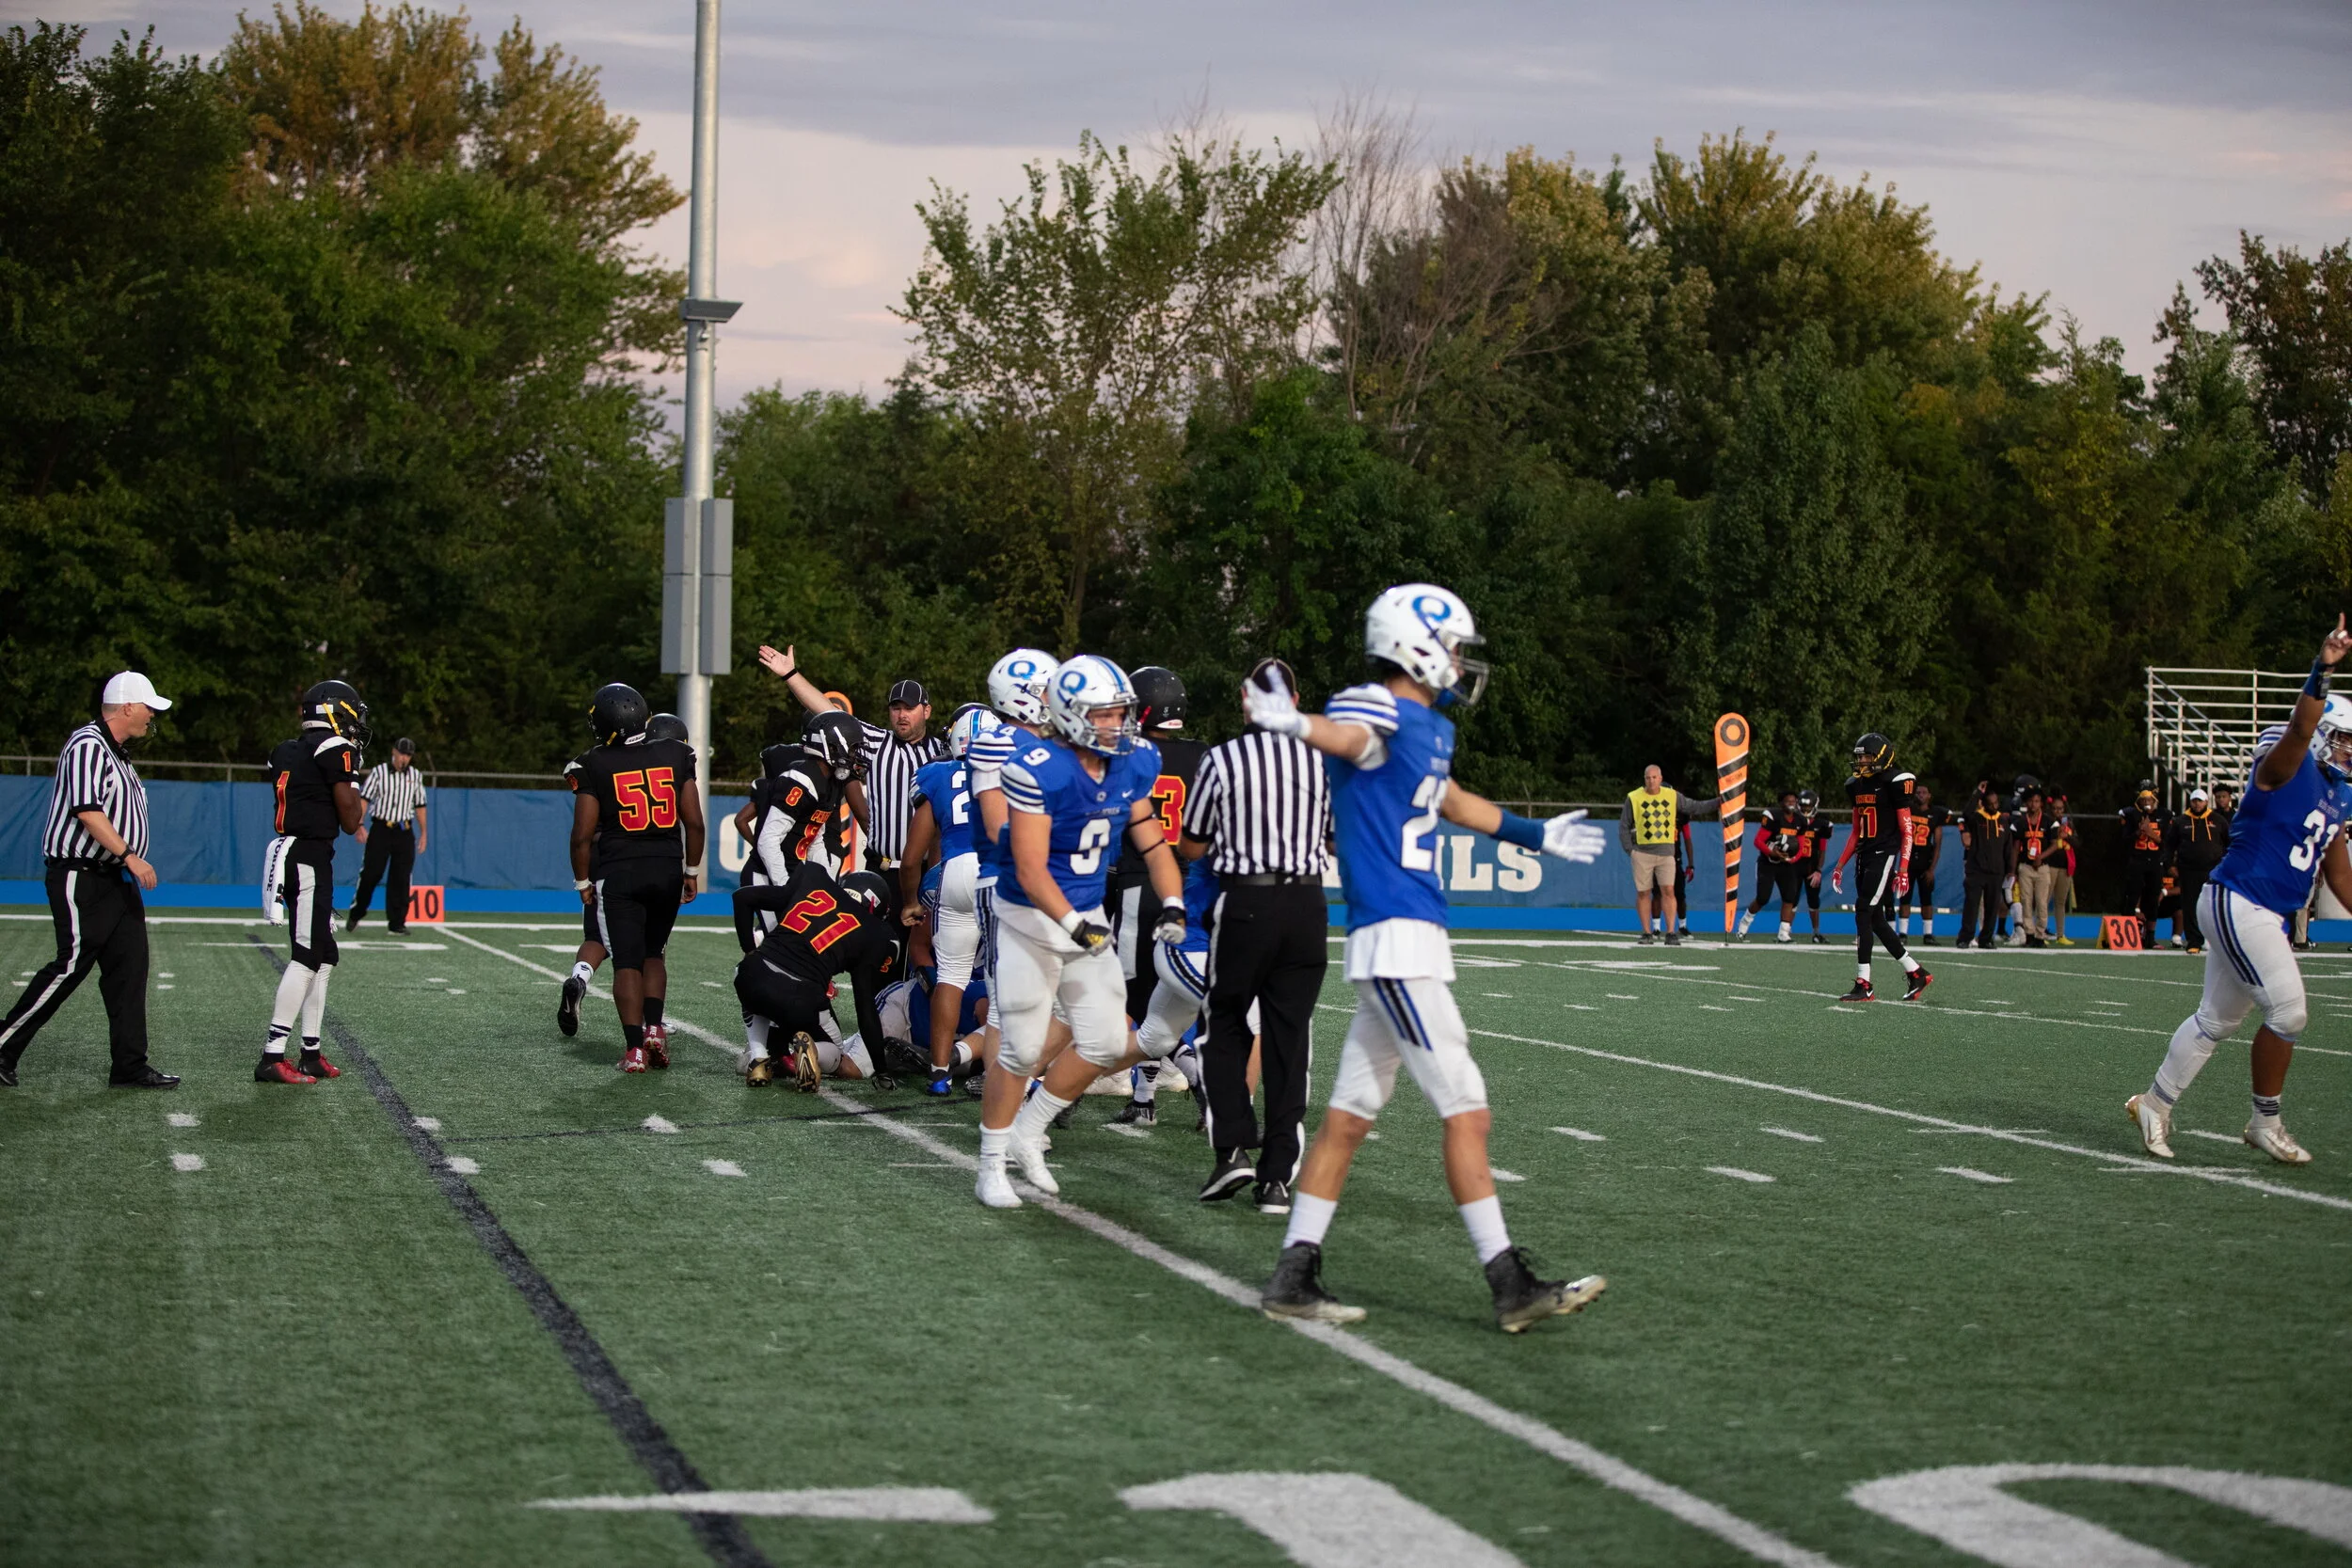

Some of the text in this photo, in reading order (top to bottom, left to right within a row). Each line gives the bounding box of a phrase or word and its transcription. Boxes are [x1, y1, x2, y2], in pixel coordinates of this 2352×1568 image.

[342, 751, 352, 772] 1
[1023, 747, 1052, 767] 9
[276, 770, 291, 833] 1
[612, 767, 677, 832] 55
[785, 785, 803, 807] 8
[1903, 780, 1915, 795] 11
[1070, 817, 1111, 876] 9
[1911, 823, 1931, 846] 2
[408, 888, 439, 920] 10
[780, 889, 862, 955] 21
[2109, 918, 2138, 949] 30
